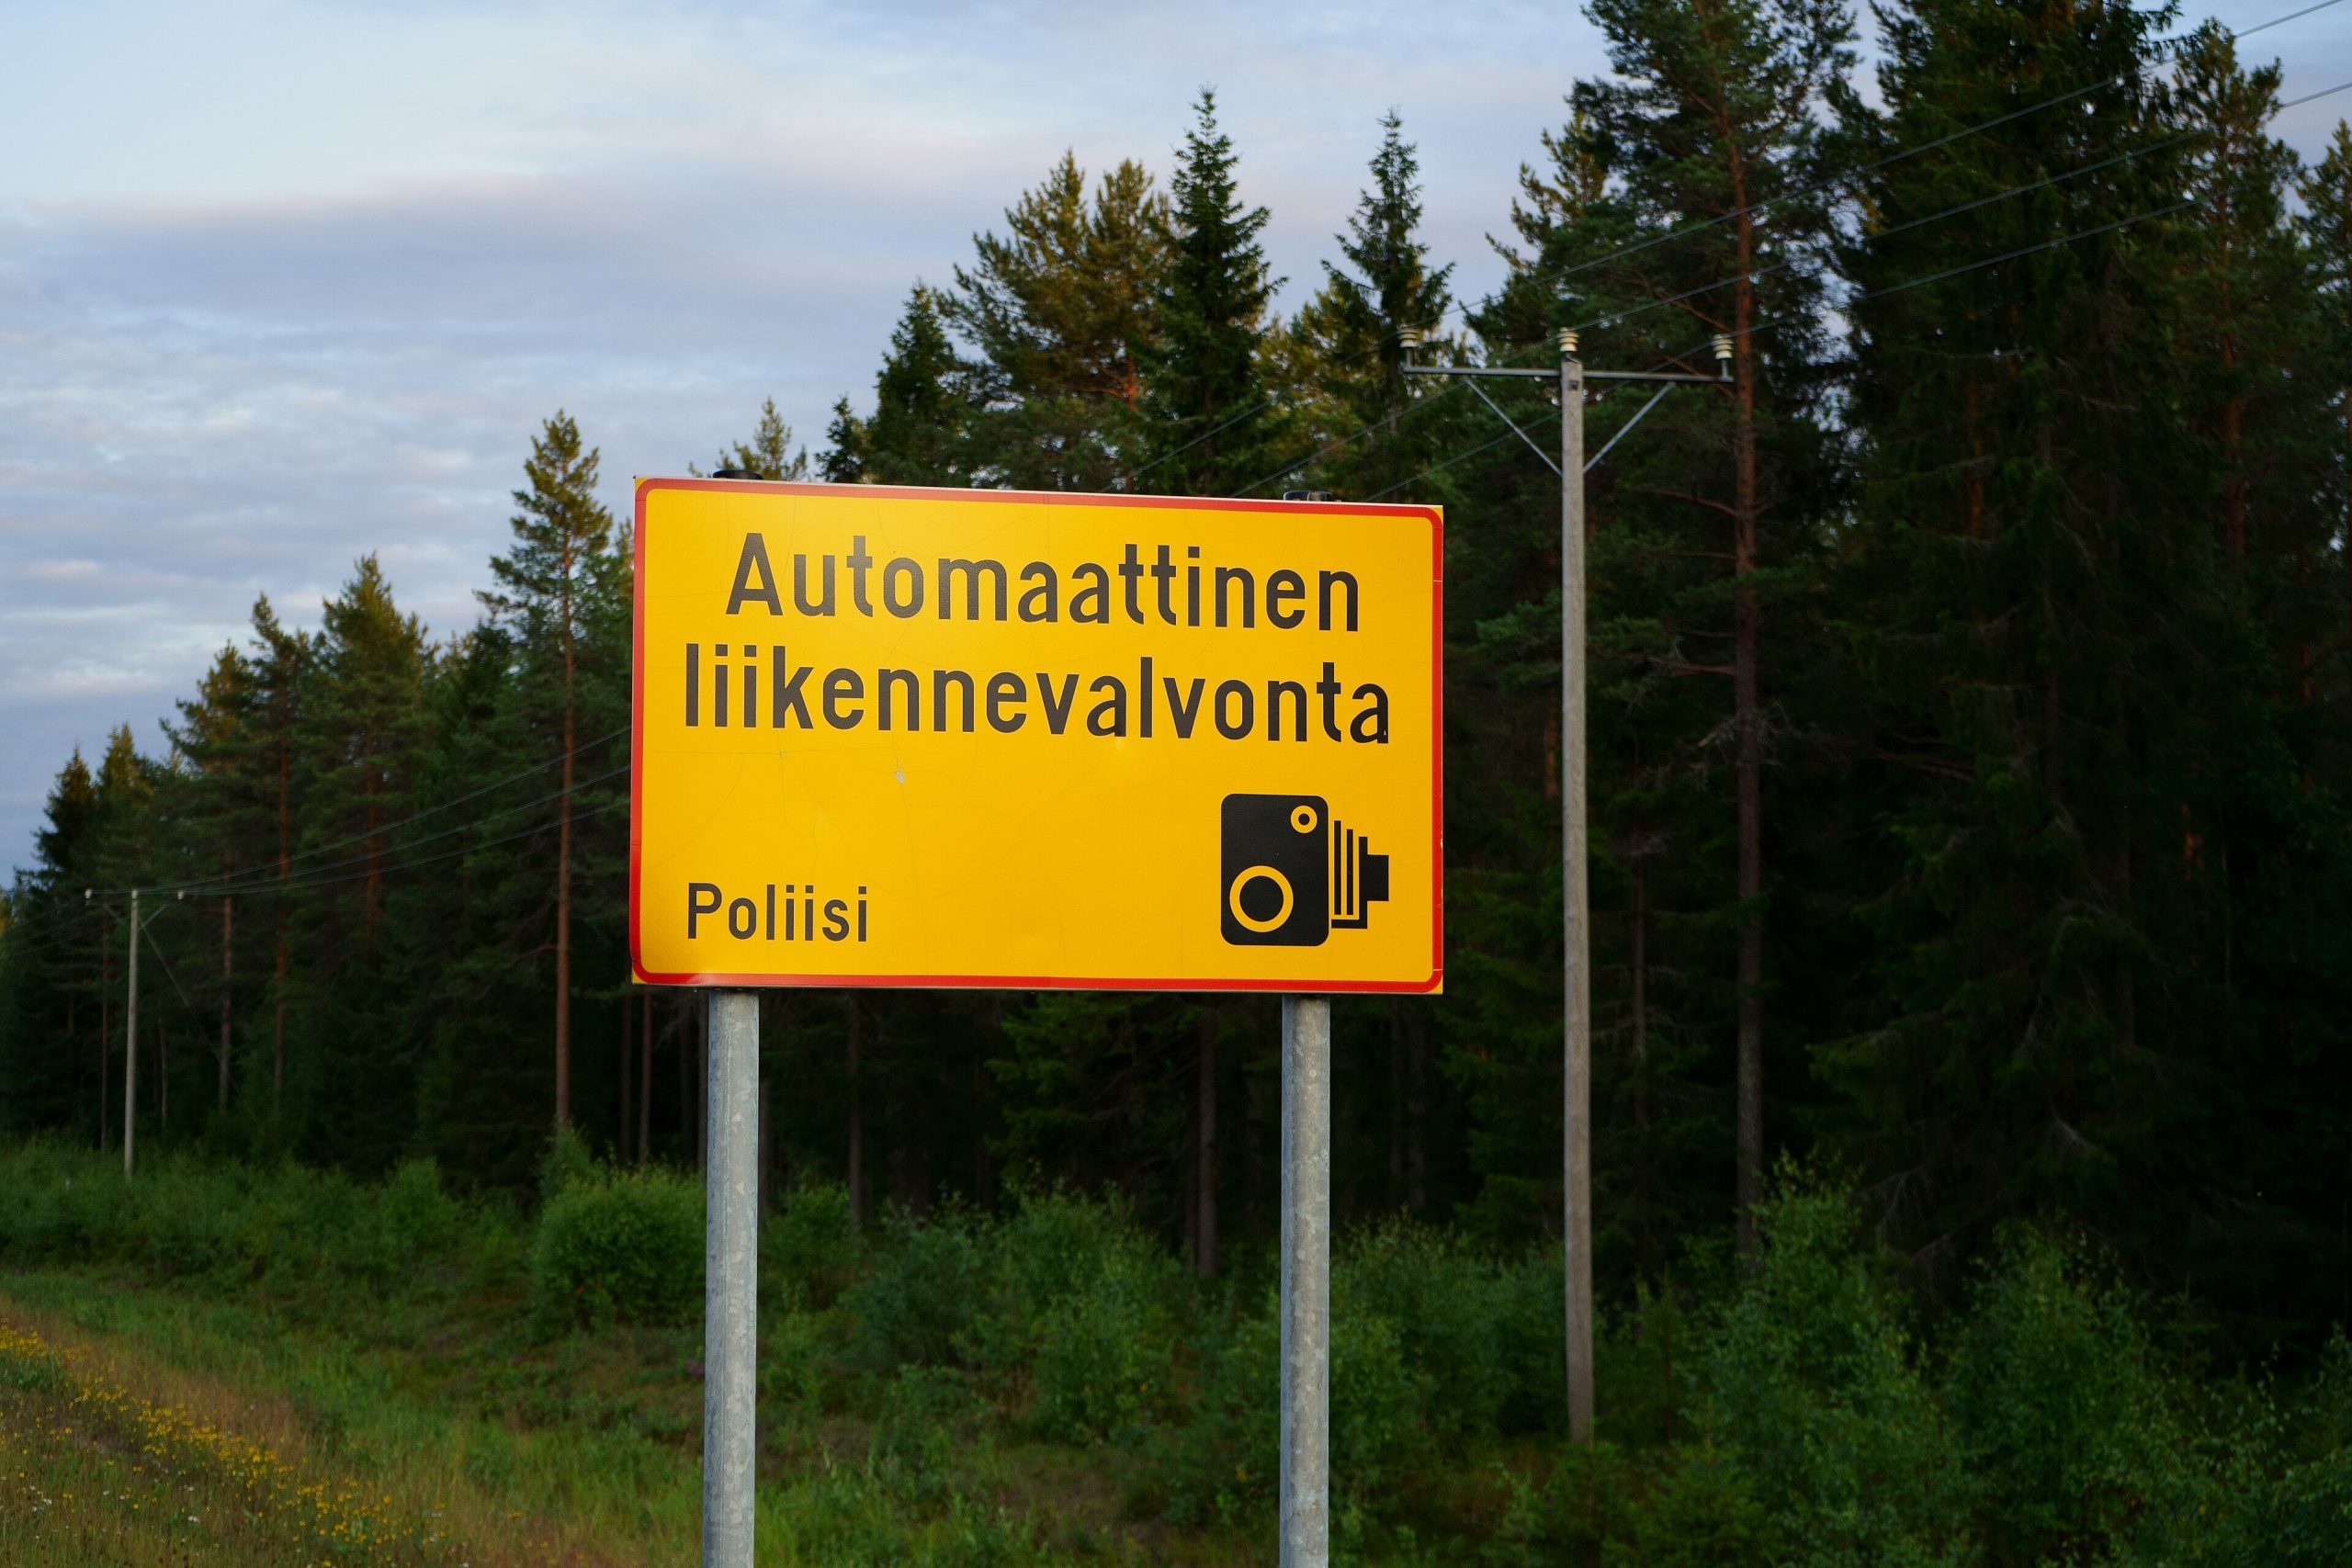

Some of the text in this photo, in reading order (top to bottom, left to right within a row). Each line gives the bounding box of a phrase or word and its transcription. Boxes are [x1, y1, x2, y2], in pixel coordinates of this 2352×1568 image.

[726, 533, 1359, 632] Automaattinen
[685, 643, 1389, 744] liikennevalvonta
[687, 882, 867, 942] Poliisi
